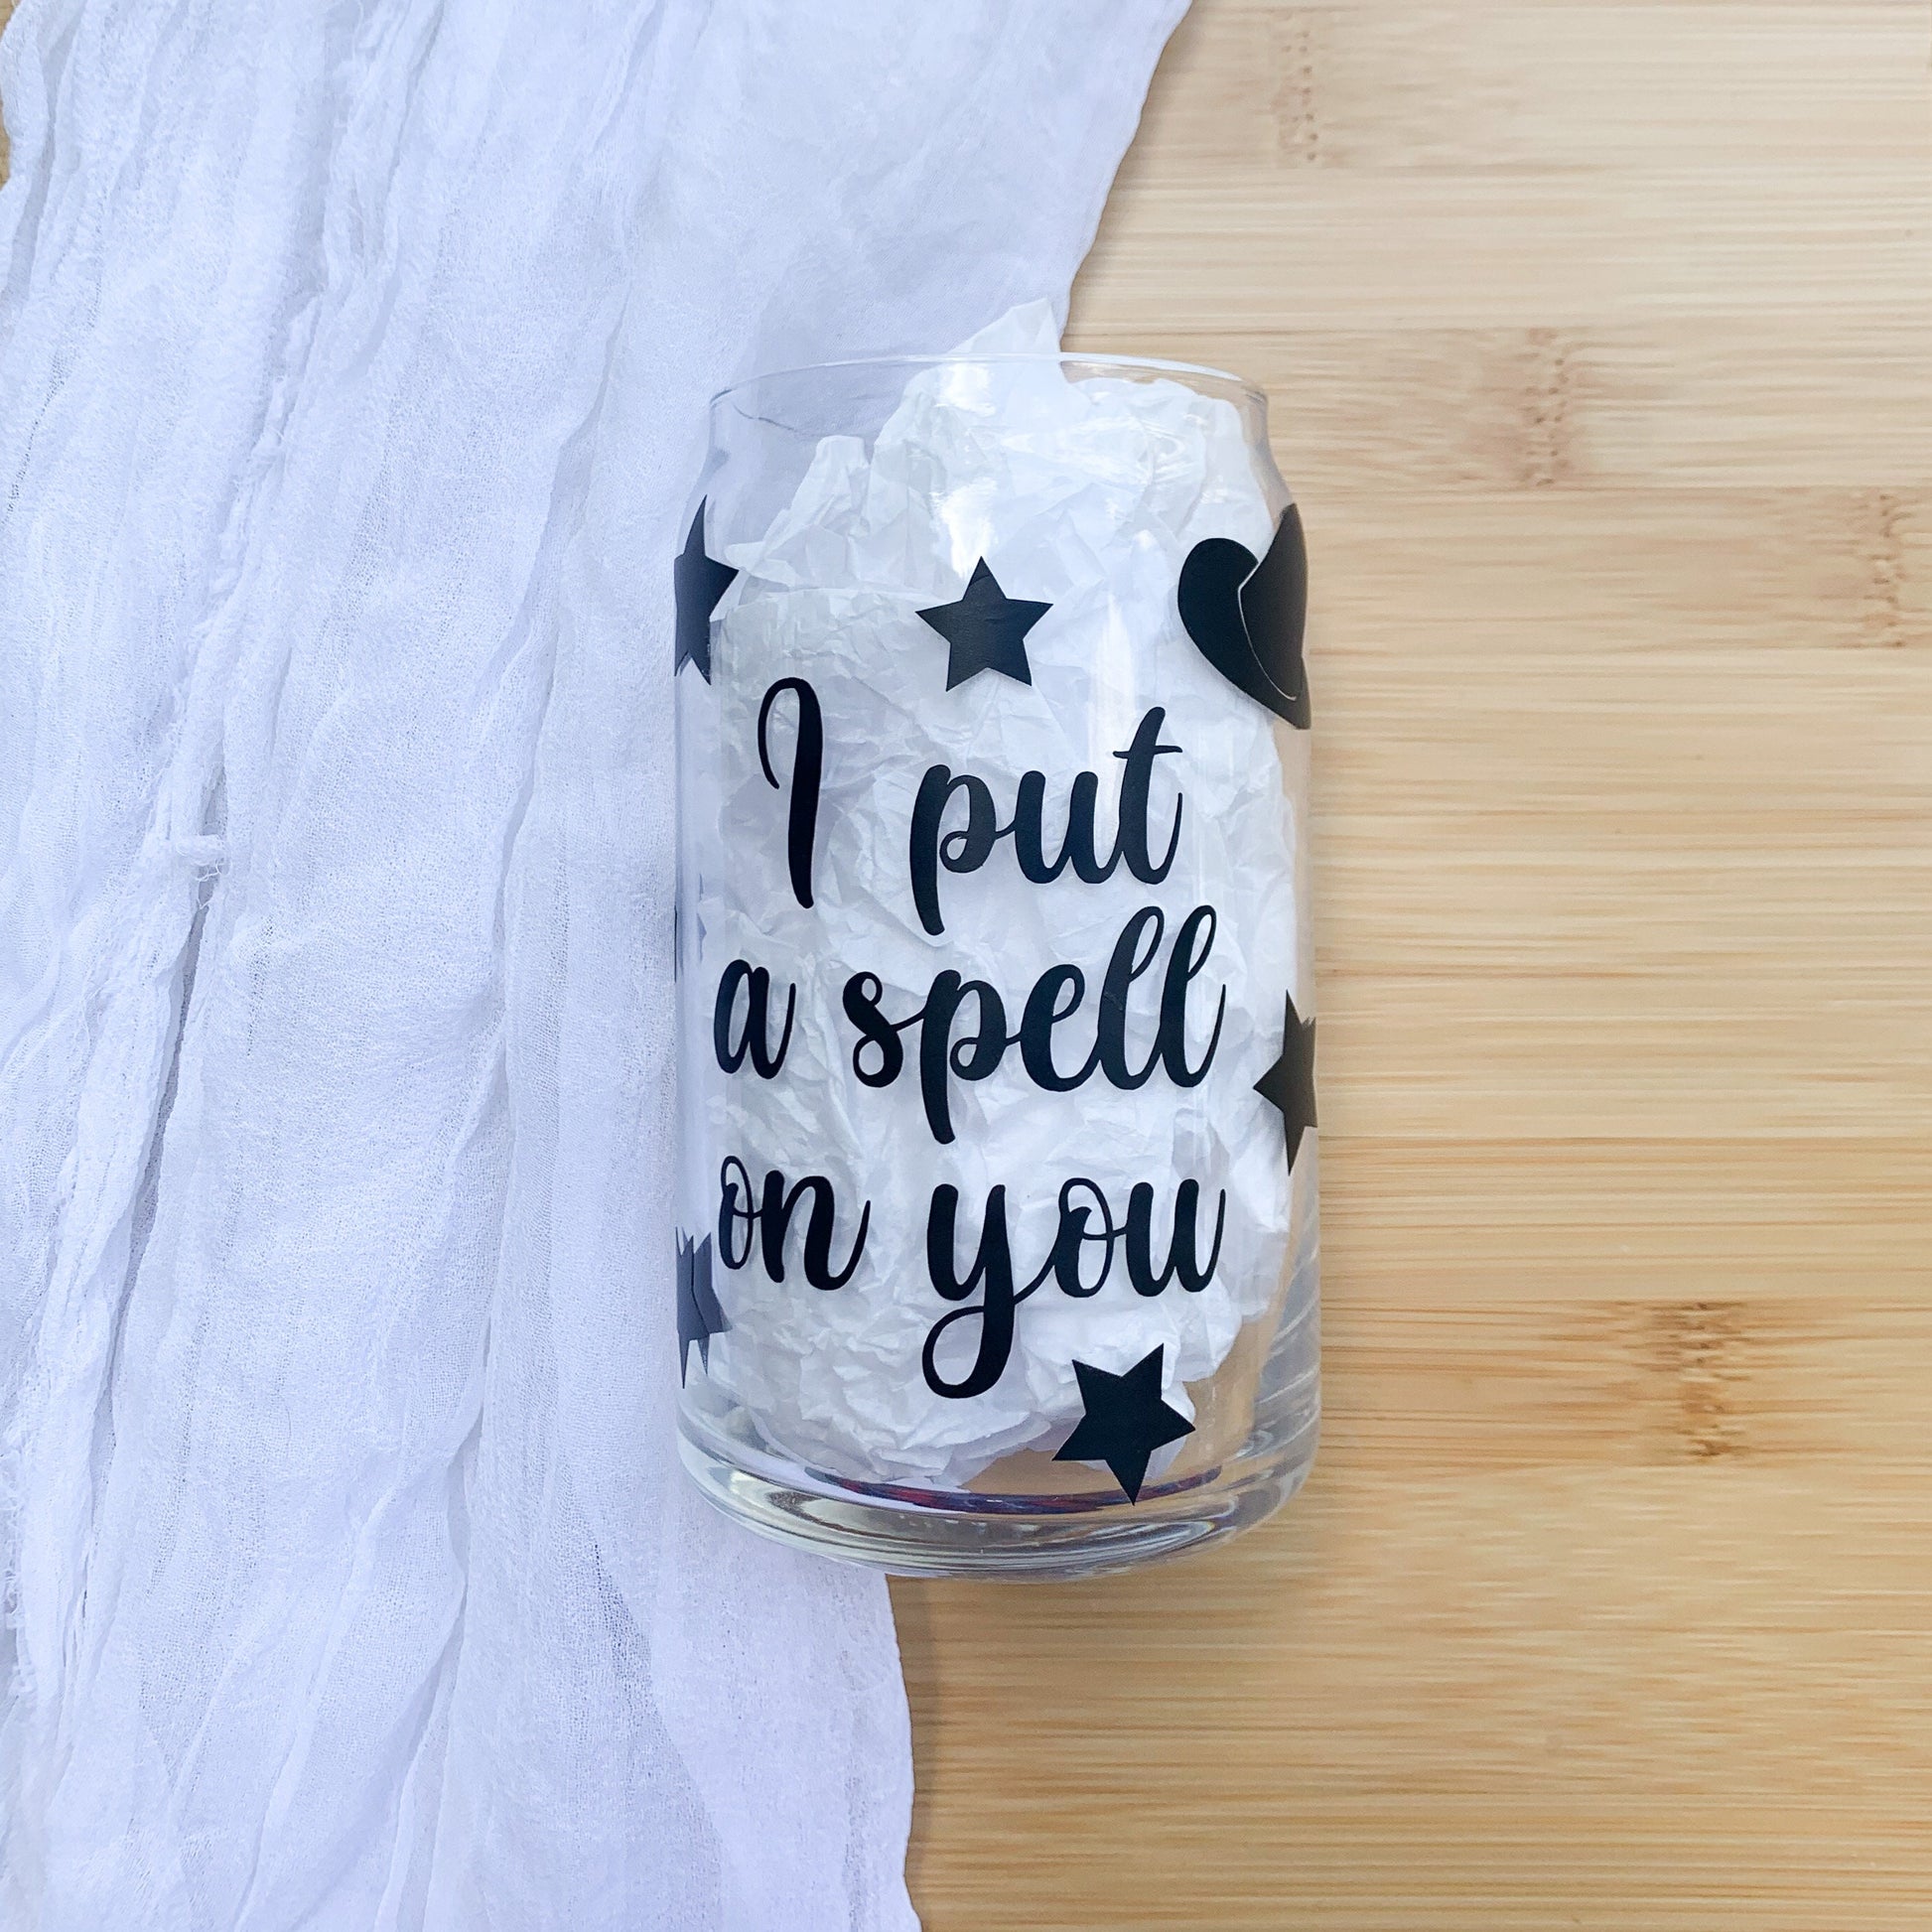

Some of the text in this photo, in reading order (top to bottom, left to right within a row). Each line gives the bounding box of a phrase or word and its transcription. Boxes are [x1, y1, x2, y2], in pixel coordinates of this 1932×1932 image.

[757, 676, 1183, 936] I put
[713, 904, 1227, 1146] a spell
[718, 1155, 1227, 1400] on you
